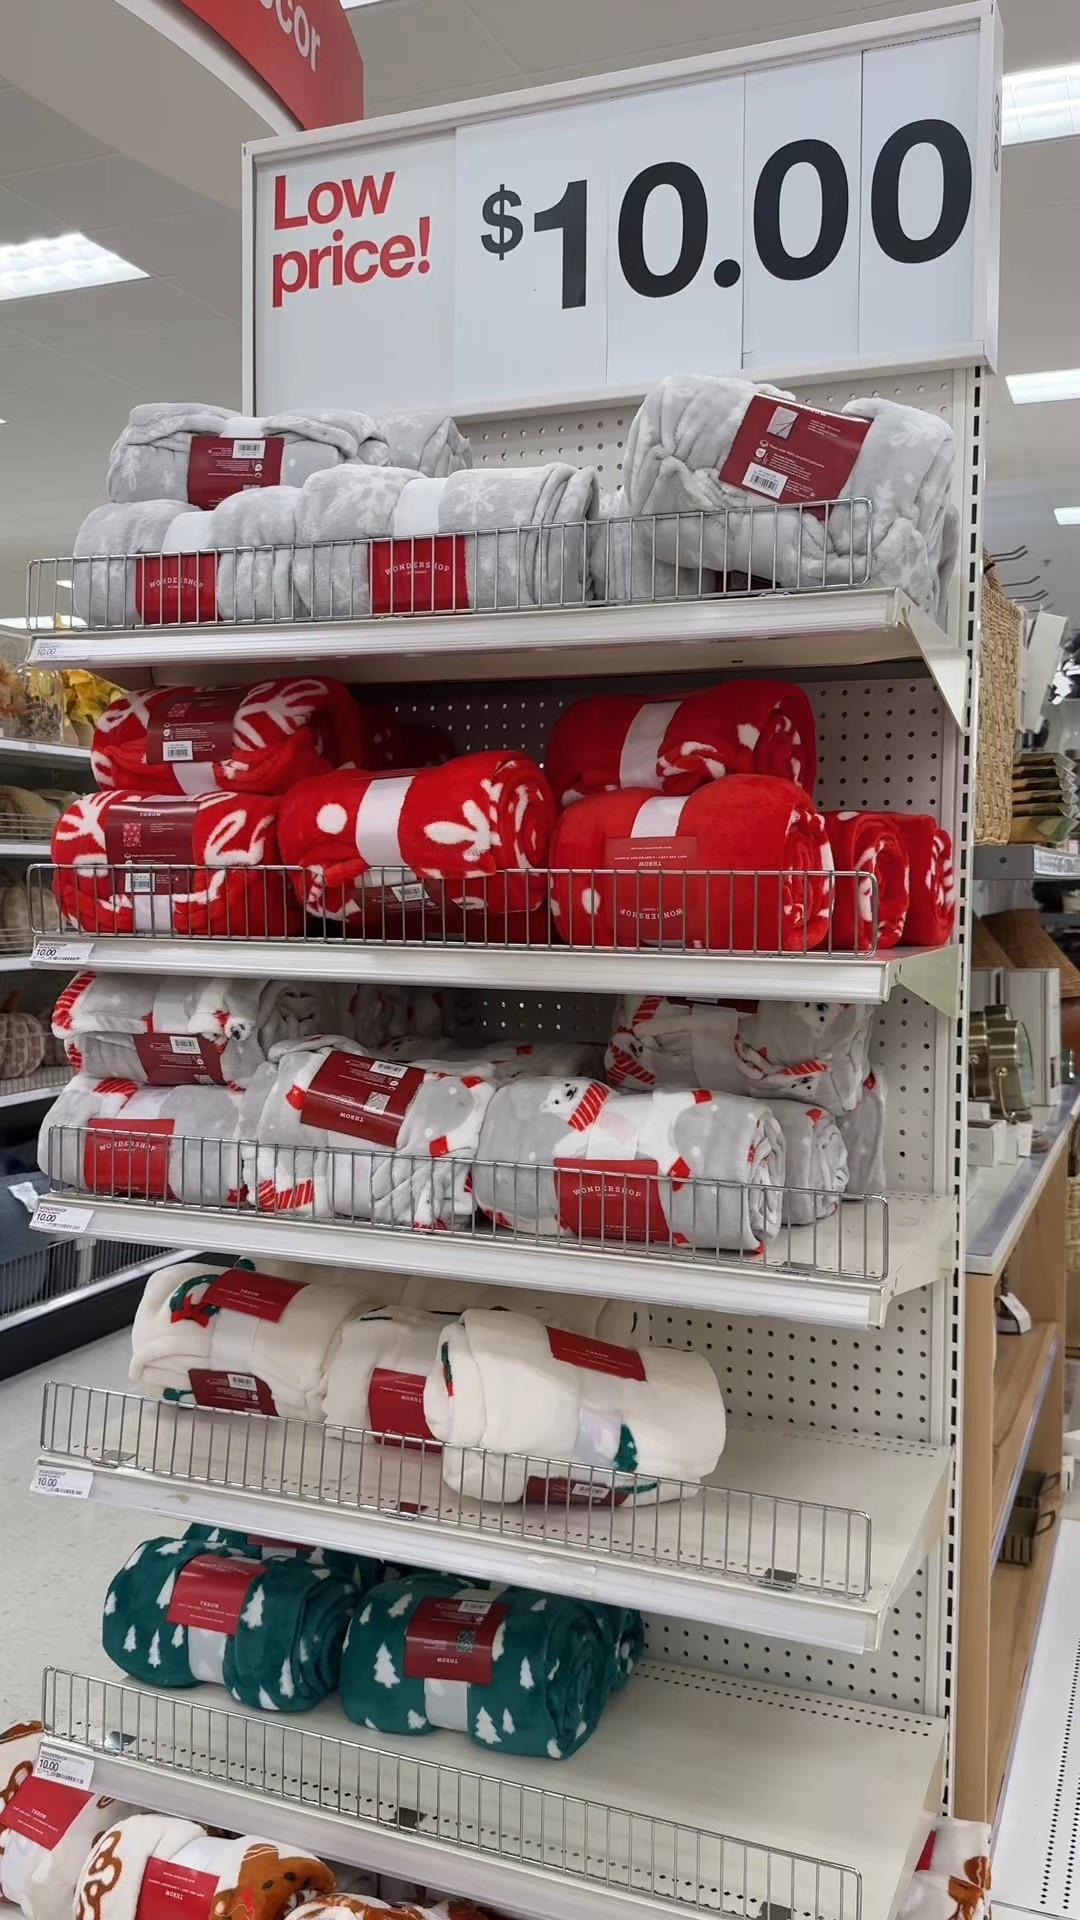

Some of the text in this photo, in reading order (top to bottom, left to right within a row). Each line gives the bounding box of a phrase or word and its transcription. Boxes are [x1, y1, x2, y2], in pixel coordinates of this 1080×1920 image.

[260, 0, 320, 72] cor
[274, 171, 396, 230] Low
[272, 216, 431, 308] price!
[36, 948, 57, 957] 10.00
[339, 1112, 364, 1123] THROW
[36, 1212, 57, 1223] 10.00
[38, 1477, 58, 1488] 10.00
[39, 1759, 60, 1772] 10.00
